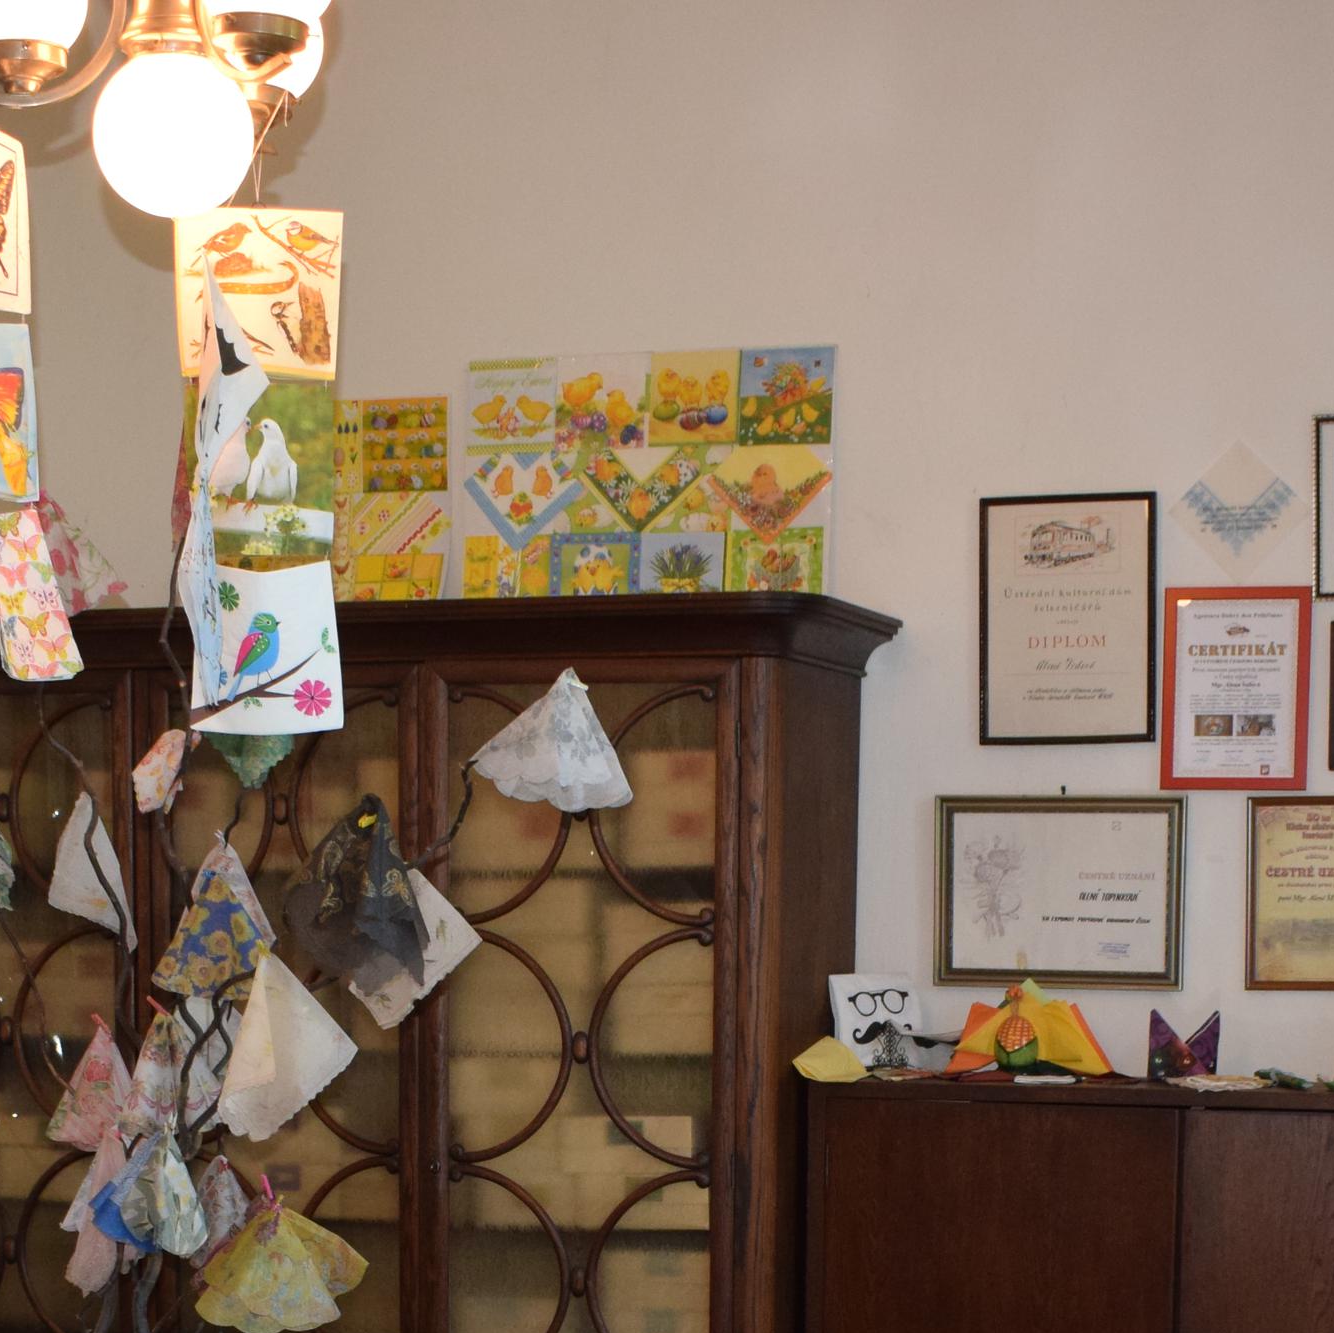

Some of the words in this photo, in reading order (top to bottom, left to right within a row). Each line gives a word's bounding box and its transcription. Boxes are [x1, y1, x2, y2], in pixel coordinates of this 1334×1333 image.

[1028, 634, 1106, 649] DIPLOM
[1188, 641, 1287, 656] CERTIFIKÁT
[1265, 866, 1314, 878] ČESTNÉ
